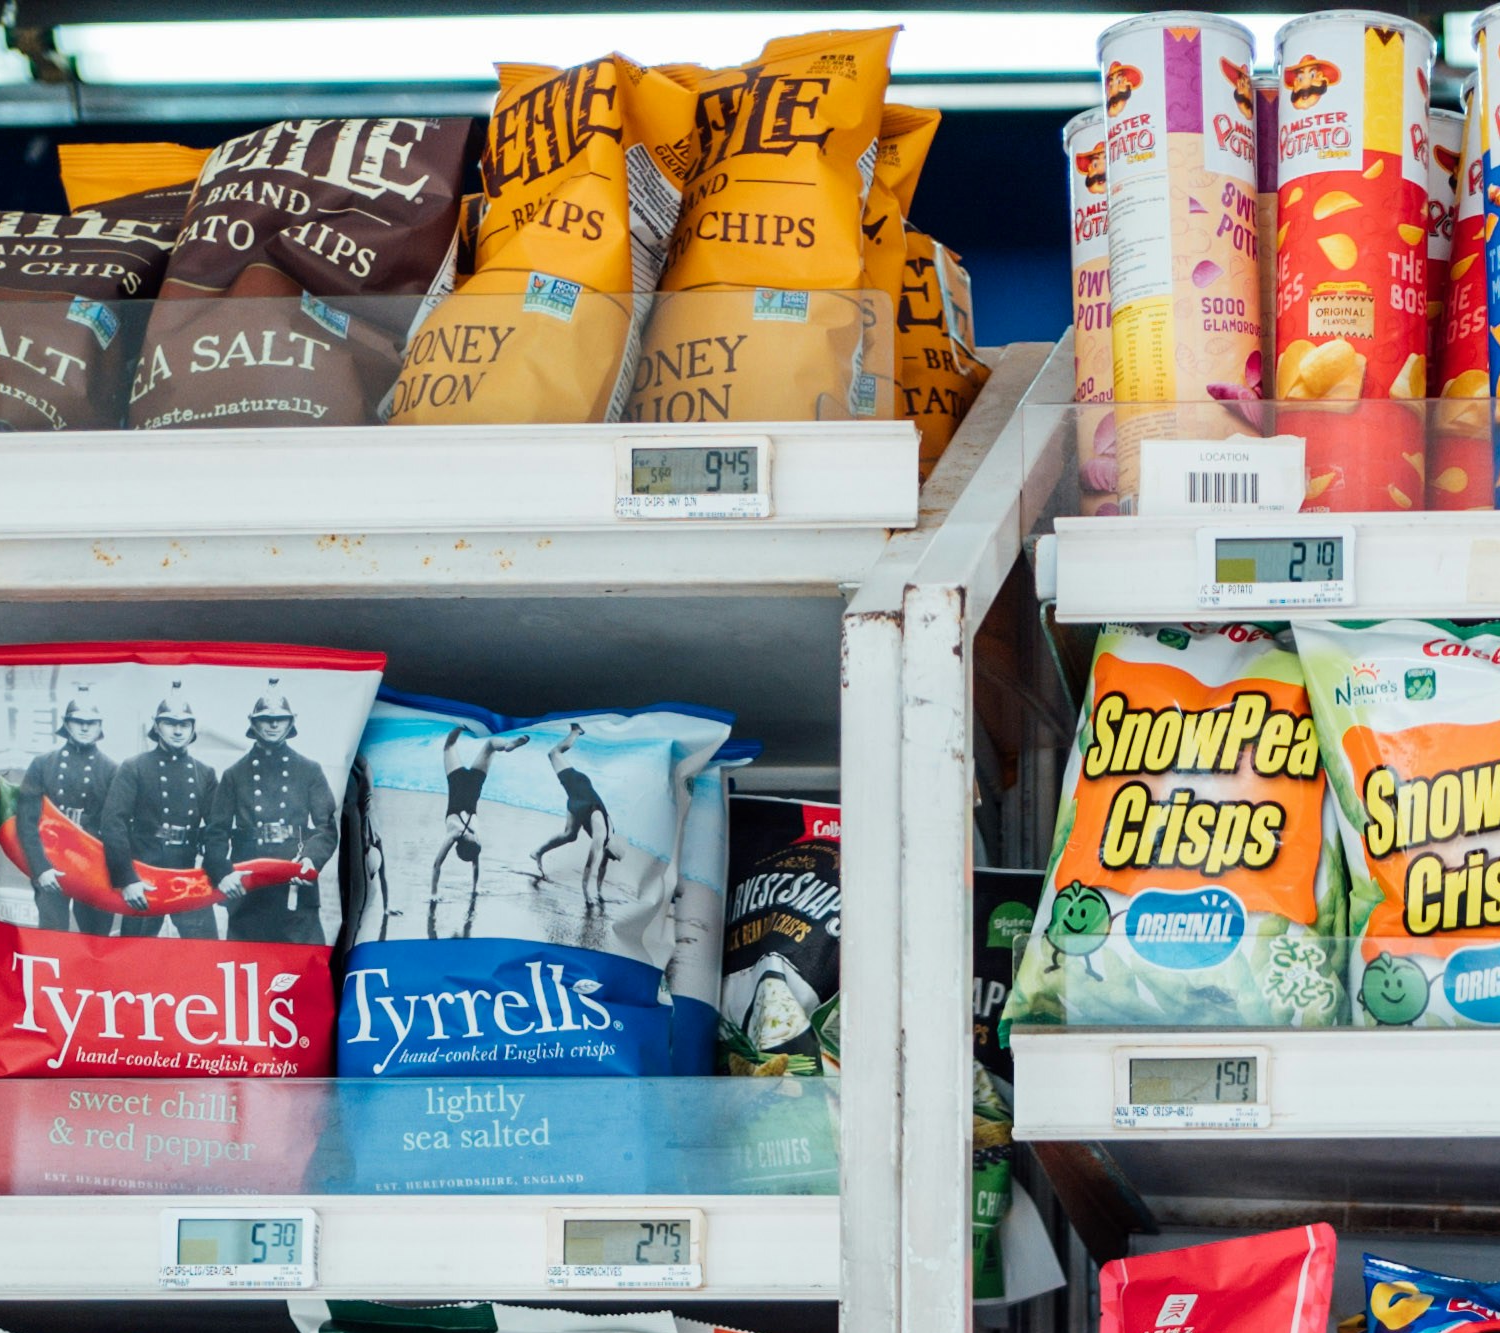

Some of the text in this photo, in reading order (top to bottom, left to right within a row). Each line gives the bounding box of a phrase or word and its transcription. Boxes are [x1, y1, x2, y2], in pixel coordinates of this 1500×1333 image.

[695, 212, 816, 249] CHIPS
[1201, 297, 1245, 316] SOOO
[1314, 305, 1366, 320] ORIGINAL
[1199, 451, 1250, 463] LOCATION
[75, 1048, 299, 1080] hand-cooked English crisps
[68, 1089, 239, 1125] sweet chilli
[425, 1087, 525, 1122] lightly
[84, 1120, 257, 1167] red pepper
[402, 1119, 550, 1151] sea salted
[404, 1173, 584, 1192] HEREFORDSHIRE, ENGLAND
